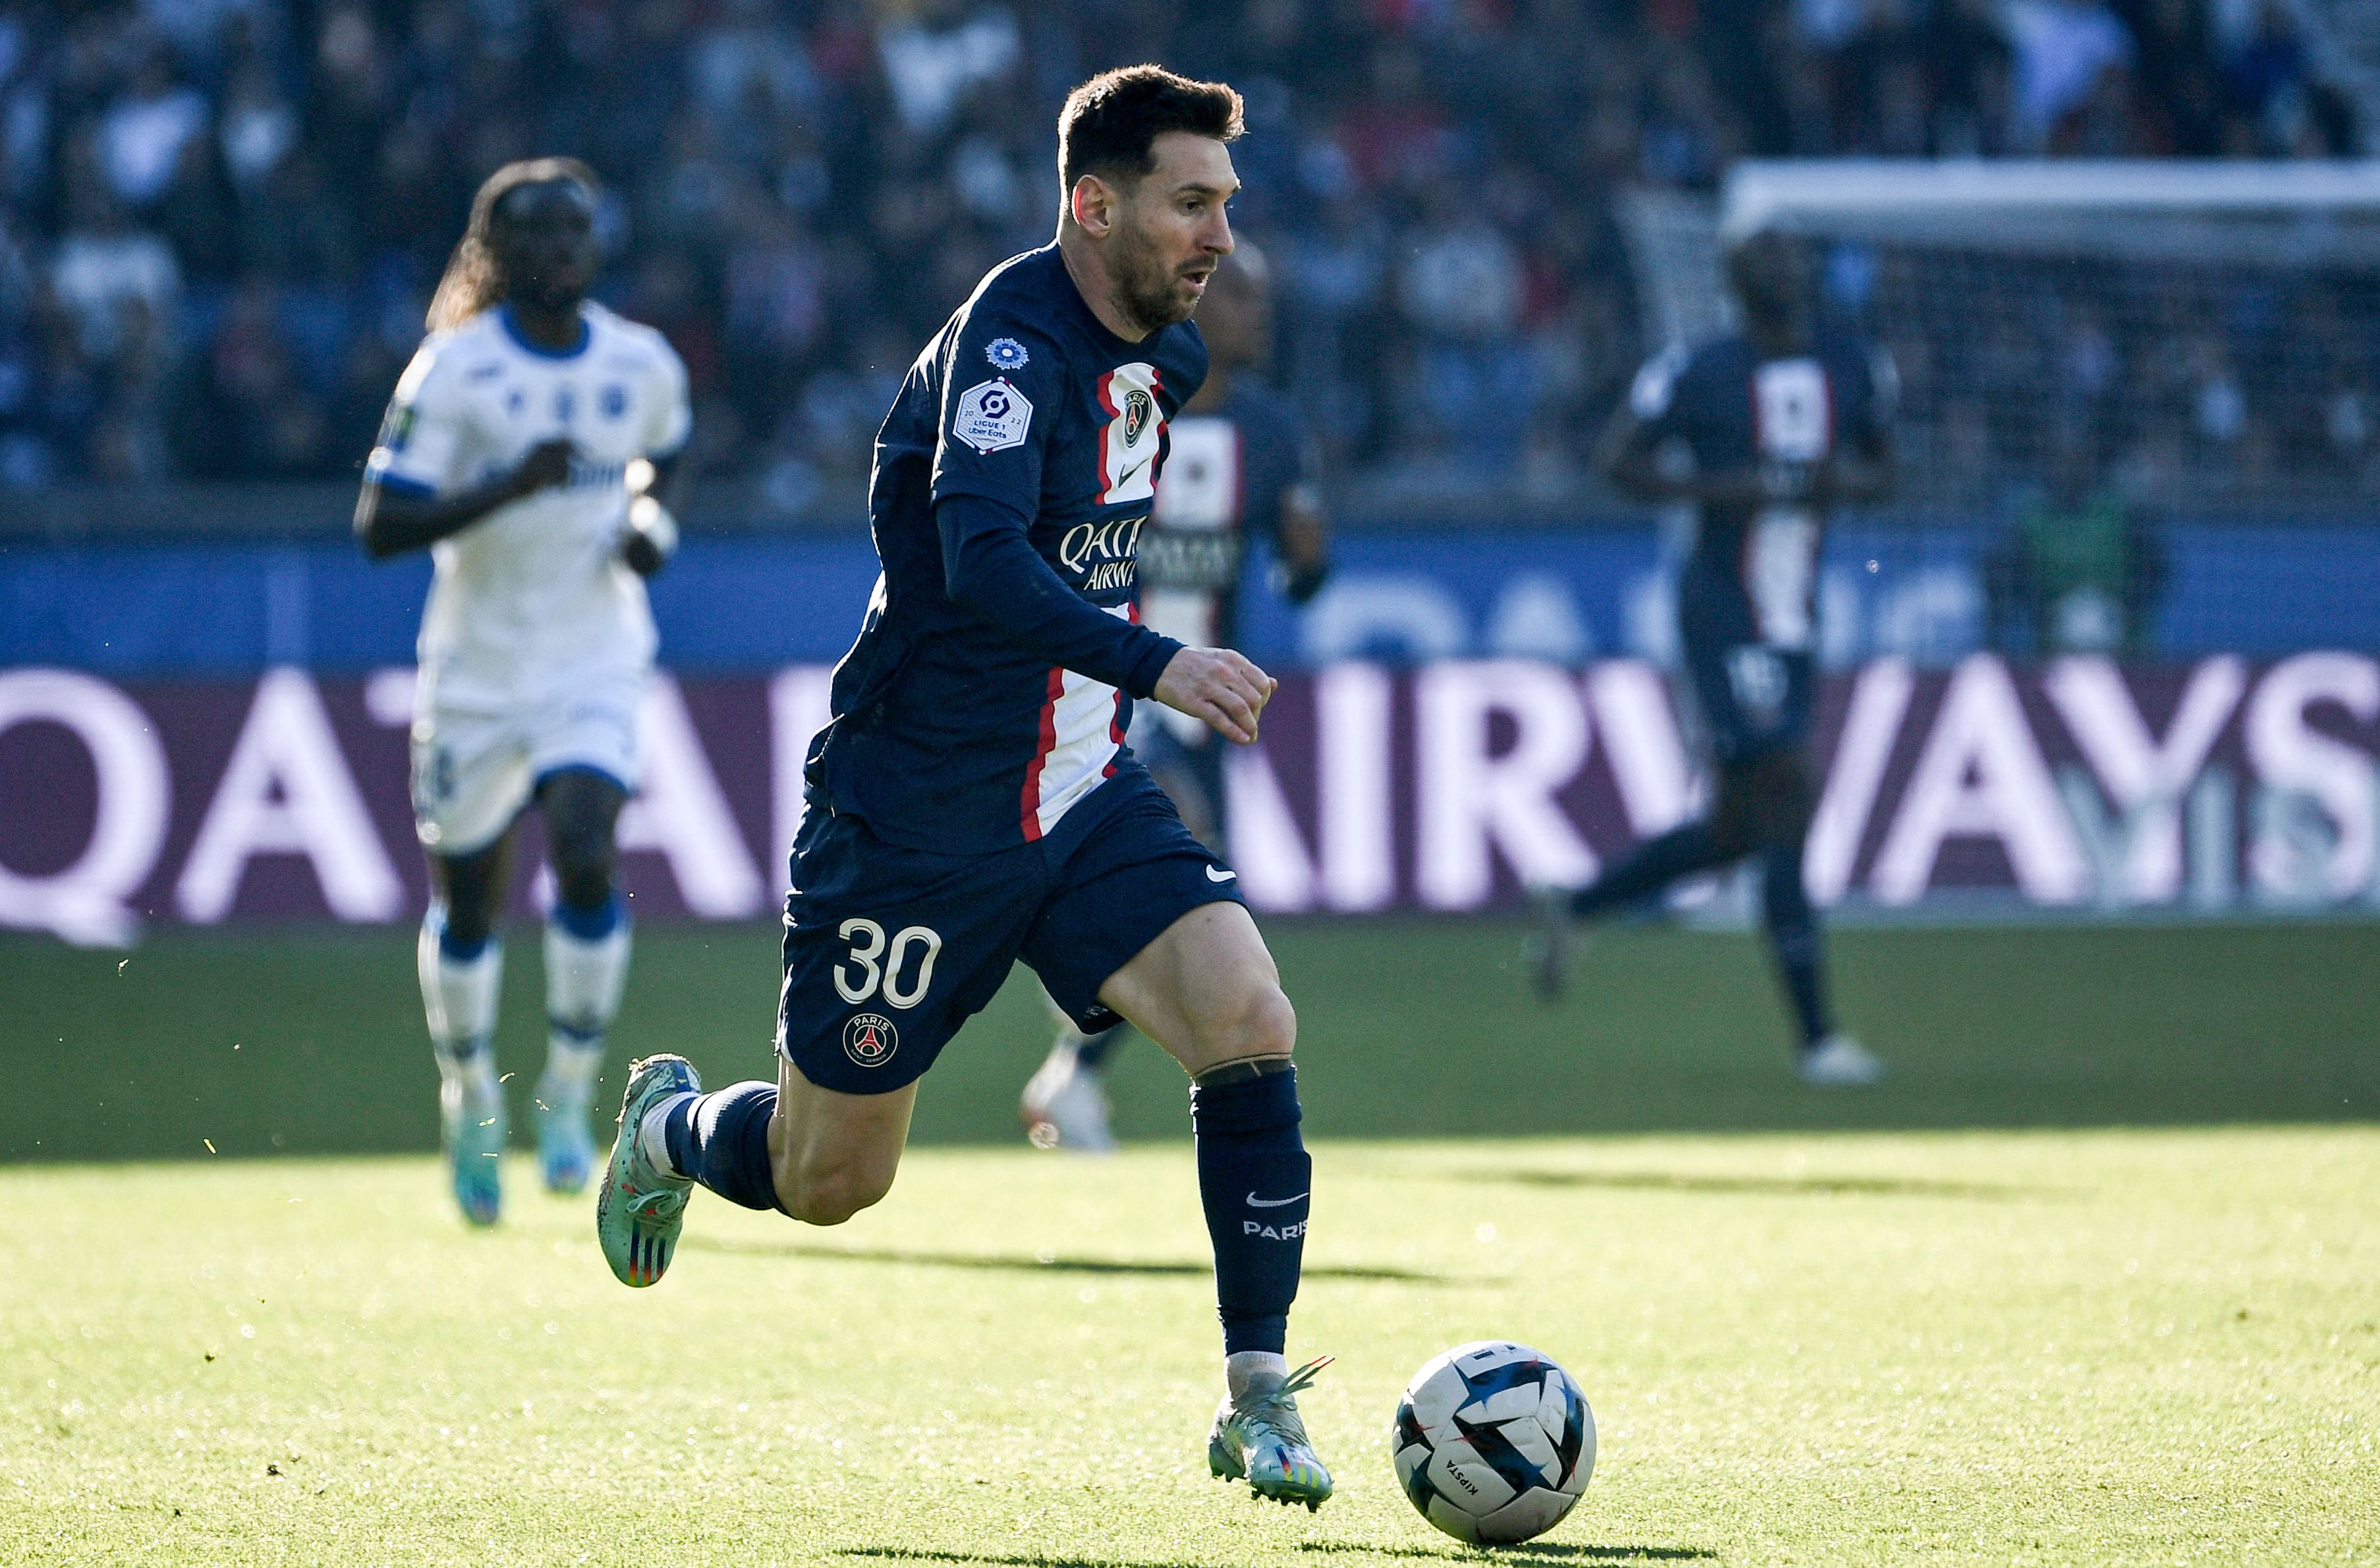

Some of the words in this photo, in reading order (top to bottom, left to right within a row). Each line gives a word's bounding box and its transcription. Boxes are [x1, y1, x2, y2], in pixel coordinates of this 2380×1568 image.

[974, 420, 1000, 429] LIGUE
[988, 429, 1007, 438] Eats
[833, 917, 942, 1010] 30
[853, 1016, 890, 1031] PARIS
[1446, 1459, 1479, 1496] KIPSTA
